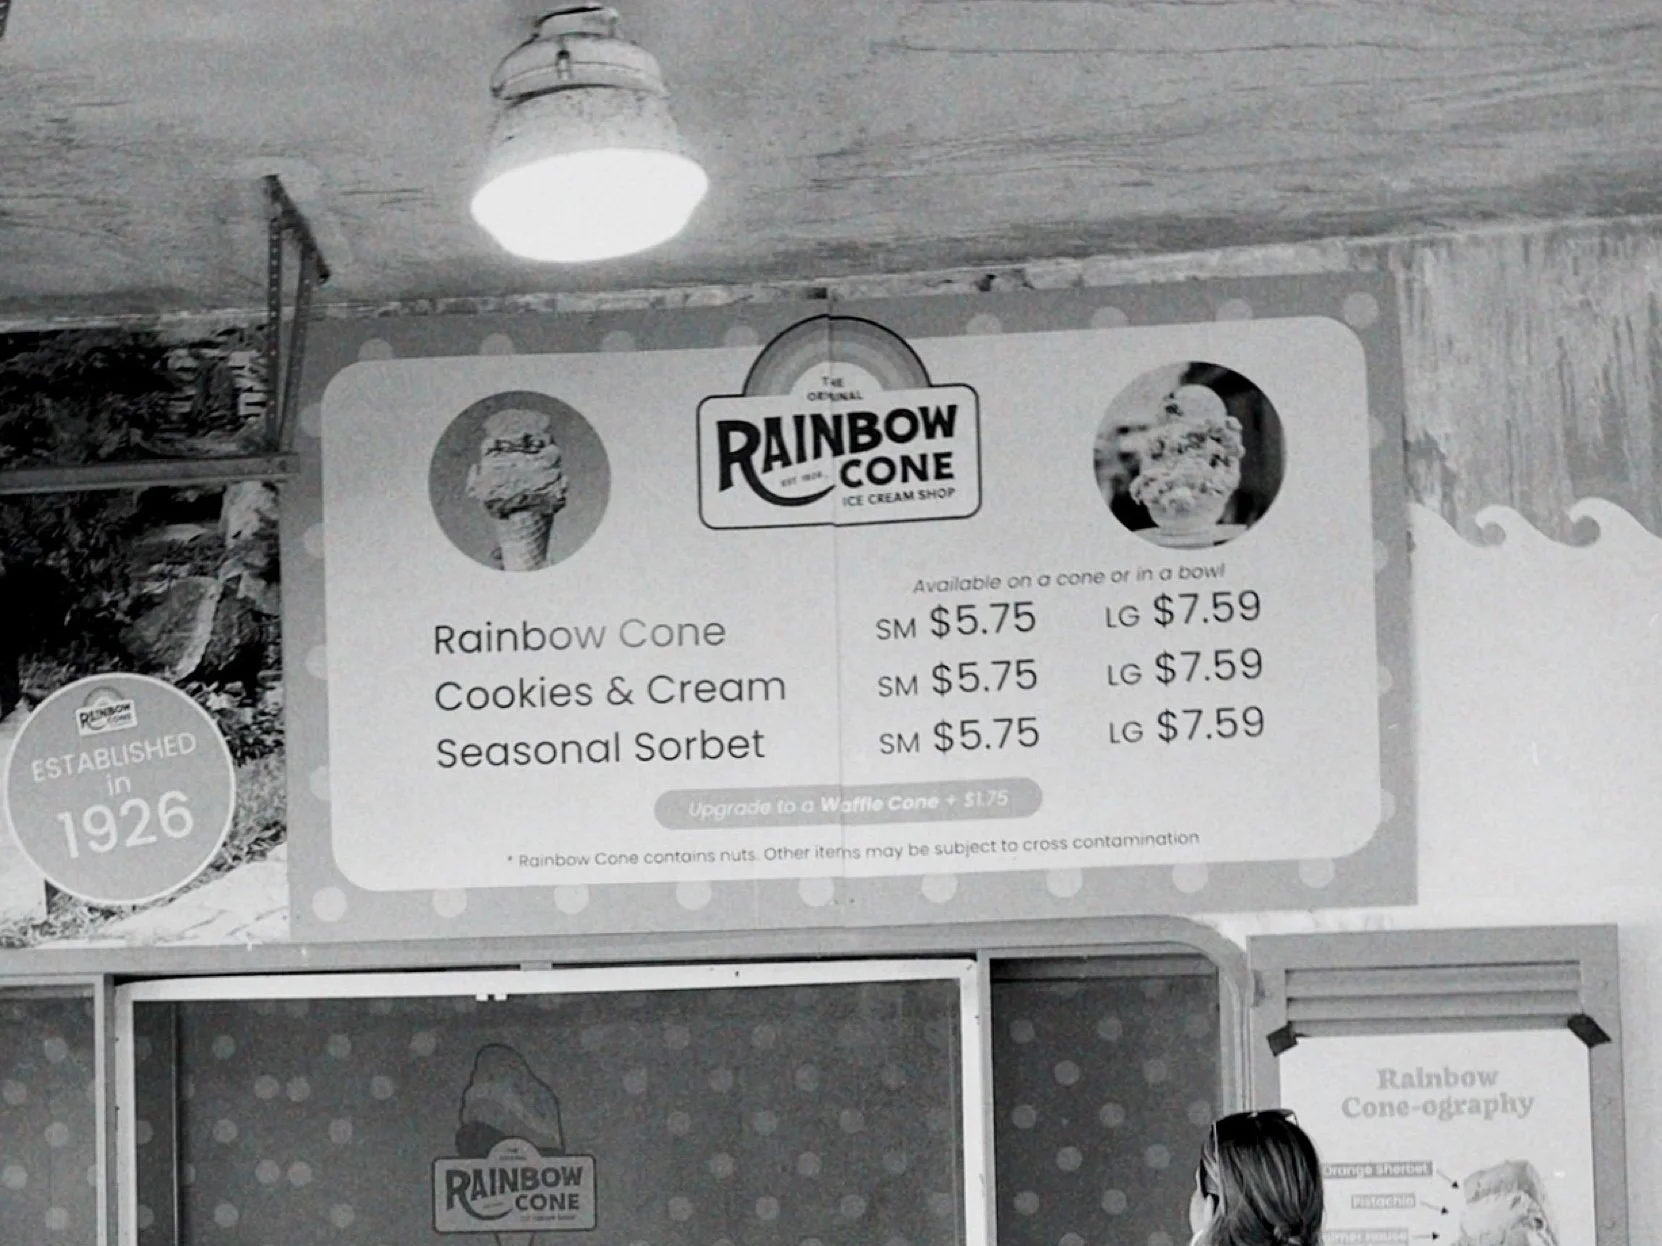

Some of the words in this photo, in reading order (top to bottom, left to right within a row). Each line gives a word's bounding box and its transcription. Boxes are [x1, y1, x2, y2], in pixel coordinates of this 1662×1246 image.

[821, 376, 845, 388] THE
[716, 404, 958, 507] RAINBOW
[839, 451, 955, 489] CONE
[842, 495, 864, 507] ICE
[868, 491, 915, 506] CREAM
[917, 487, 956, 500] SHOP
[912, 574, 1001, 595] Available
[1007, 576, 1032, 590] on
[1037, 575, 1052, 588] a
[1056, 571, 1106, 588] cone
[1111, 569, 1131, 585] or
[1135, 567, 1155, 583] in
[1158, 567, 1173, 582] a
[1177, 562, 1226, 582] bowl
[875, 617, 917, 641] SM
[929, 601, 1037, 640] $5.75
[1105, 605, 1141, 629] LG
[1153, 589, 1262, 629] $7.59
[434, 620, 607, 655] Rainbow
[619, 618, 727, 649] Cone
[877, 674, 919, 698] SM
[931, 658, 1038, 698] $5.75
[1106, 663, 1142, 687] LG
[1154, 647, 1264, 687] $7.59
[435, 675, 594, 712] Cookies
[605, 675, 635, 706] &
[647, 674, 787, 705] Cream
[879, 732, 921, 756] SM
[933, 716, 1041, 755] $5.75
[1108, 721, 1144, 745] LG
[1156, 705, 1265, 745] $7.59
[31, 732, 197, 782] ESTABLISHED
[436, 731, 622, 769] Seasonal
[634, 728, 766, 763] Sorbet
[105, 773, 132, 796] in
[56, 790, 194, 859] 1926
[688, 800, 772, 821] Upgrade
[777, 799, 798, 815] to
[801, 801, 814, 815] a
[820, 794, 884, 815] Waffle
[887, 794, 940, 812] Cone
[945, 793, 957, 807] +
[962, 789, 1010, 810] $1.75
[518, 853, 590, 869] Rainbow
[594, 851, 639, 867] Cone
[643, 849, 716, 866] contains
[720, 849, 758, 863] nuts.
[763, 845, 809, 862] Other
[814, 844, 861, 861] items
[866, 846, 902, 862] may
[908, 843, 930, 858] be
[934, 839, 998, 860] subject
[1001, 838, 1018, 853] to
[1022, 838, 1068, 852] cross
[1072, 830, 1201, 850] contamination
[1376, 1065, 1500, 1090] Rainbow
[1341, 1092, 1535, 1121] Cone-ography
[445, 1166, 583, 1221] RAINBOW
[515, 1192, 580, 1212] CONE
